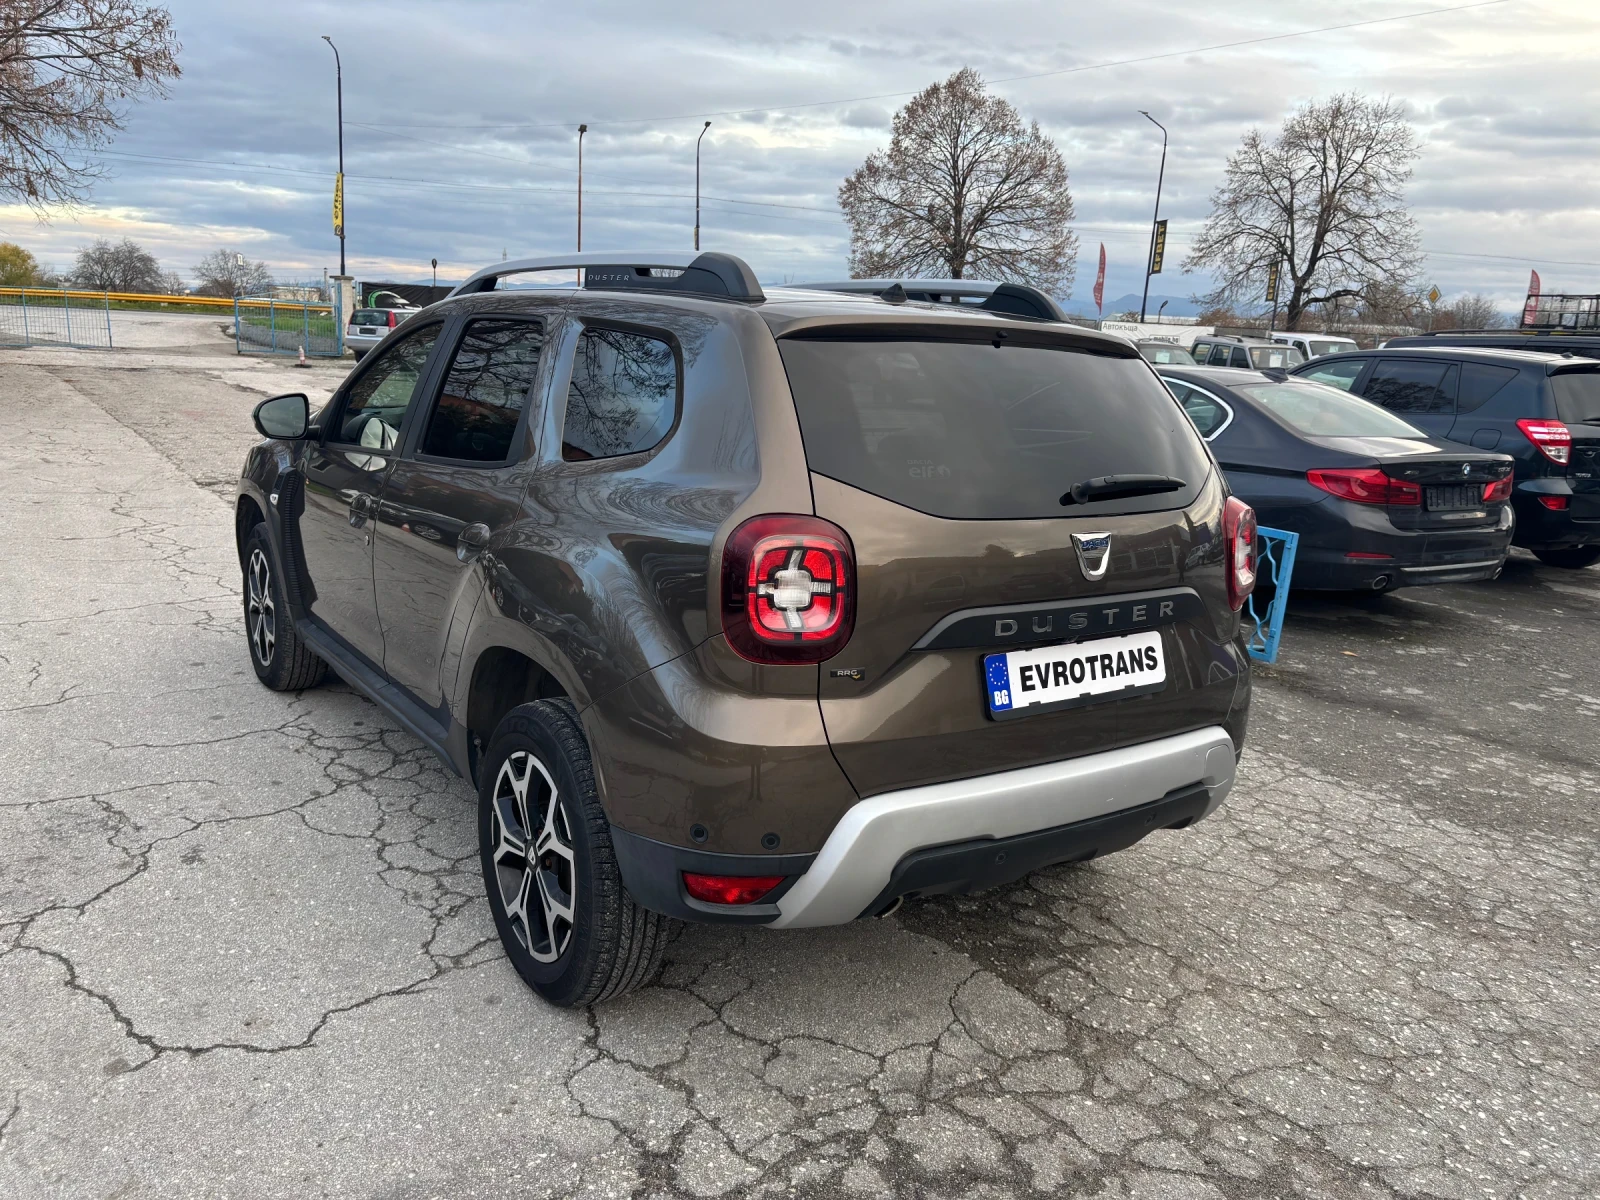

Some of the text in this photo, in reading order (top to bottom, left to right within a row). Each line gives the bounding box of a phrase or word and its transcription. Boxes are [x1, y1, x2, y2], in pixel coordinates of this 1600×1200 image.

[1153, 224, 1165, 271] EFBET
[1102, 322, 1138, 332] Автокъща
[908, 466, 935, 478] elf
[995, 601, 1174, 637] DUSTER
[1020, 646, 1158, 692] EVROTRANS
[993, 690, 1010, 706] BG
